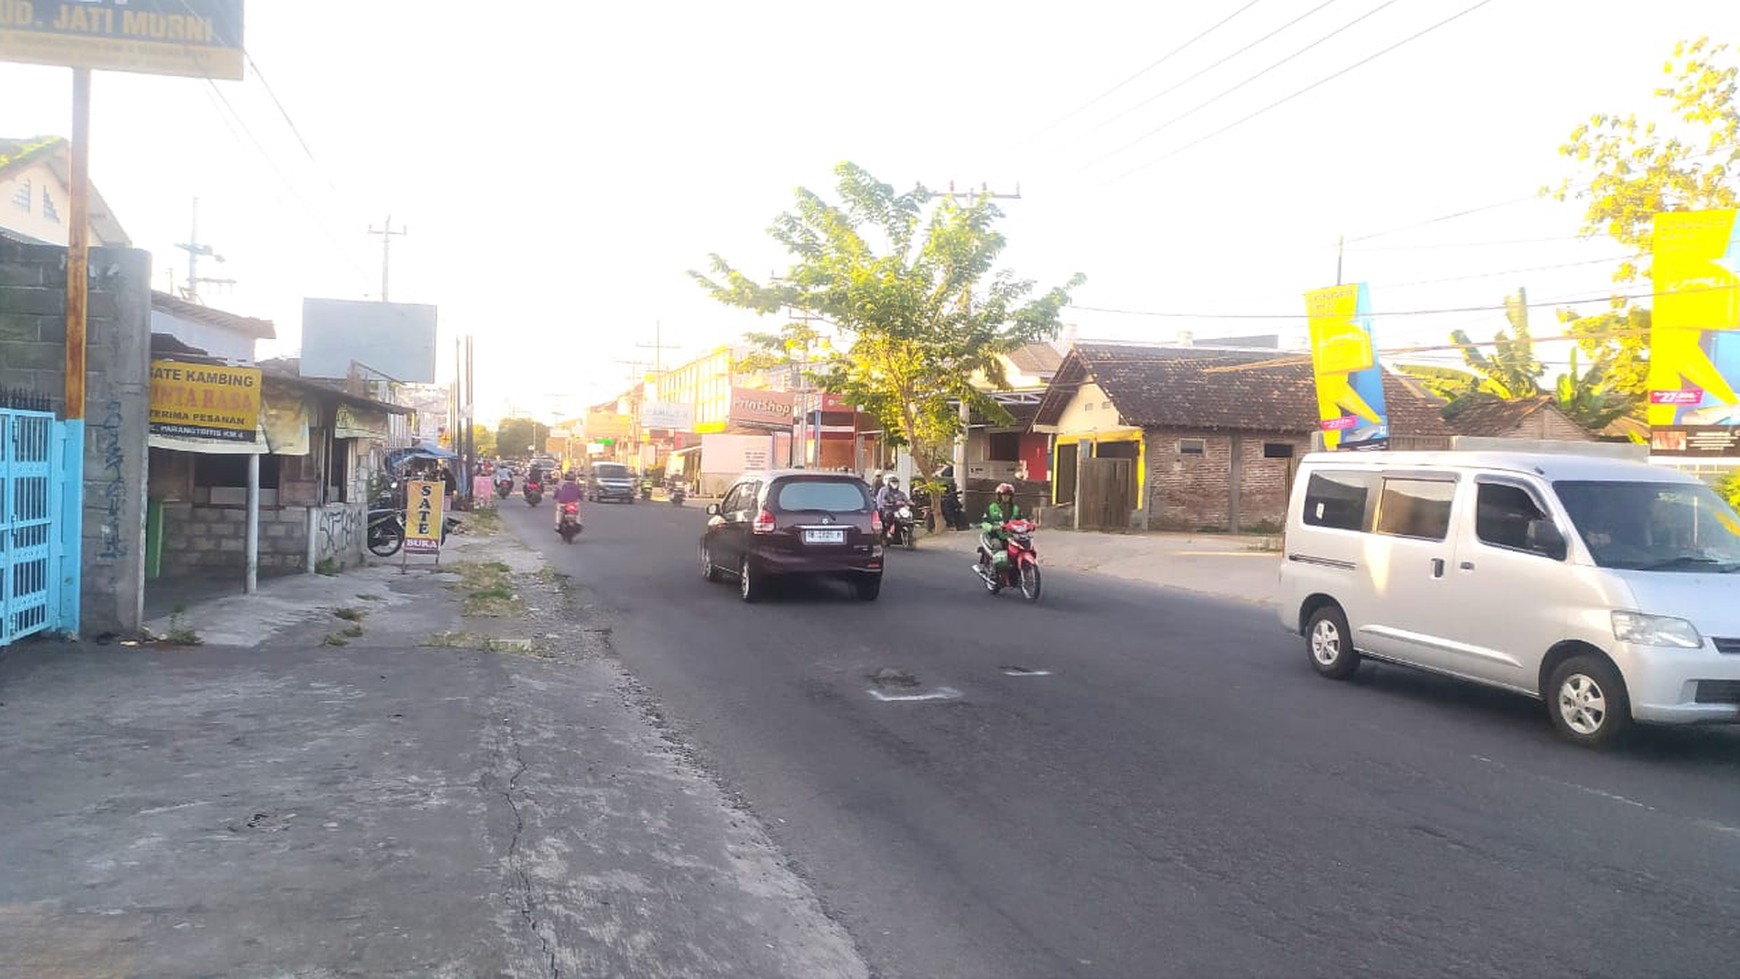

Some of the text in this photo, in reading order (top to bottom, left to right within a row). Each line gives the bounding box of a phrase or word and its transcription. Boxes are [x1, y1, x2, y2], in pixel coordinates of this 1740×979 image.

[53, 4, 114, 33] JATI
[122, 10, 213, 42] MURNI
[186, 371, 254, 387] KAMBING
[193, 414, 245, 425] PESANAN
[419, 486, 432, 534] SATE
[407, 539, 437, 548] BUKA
